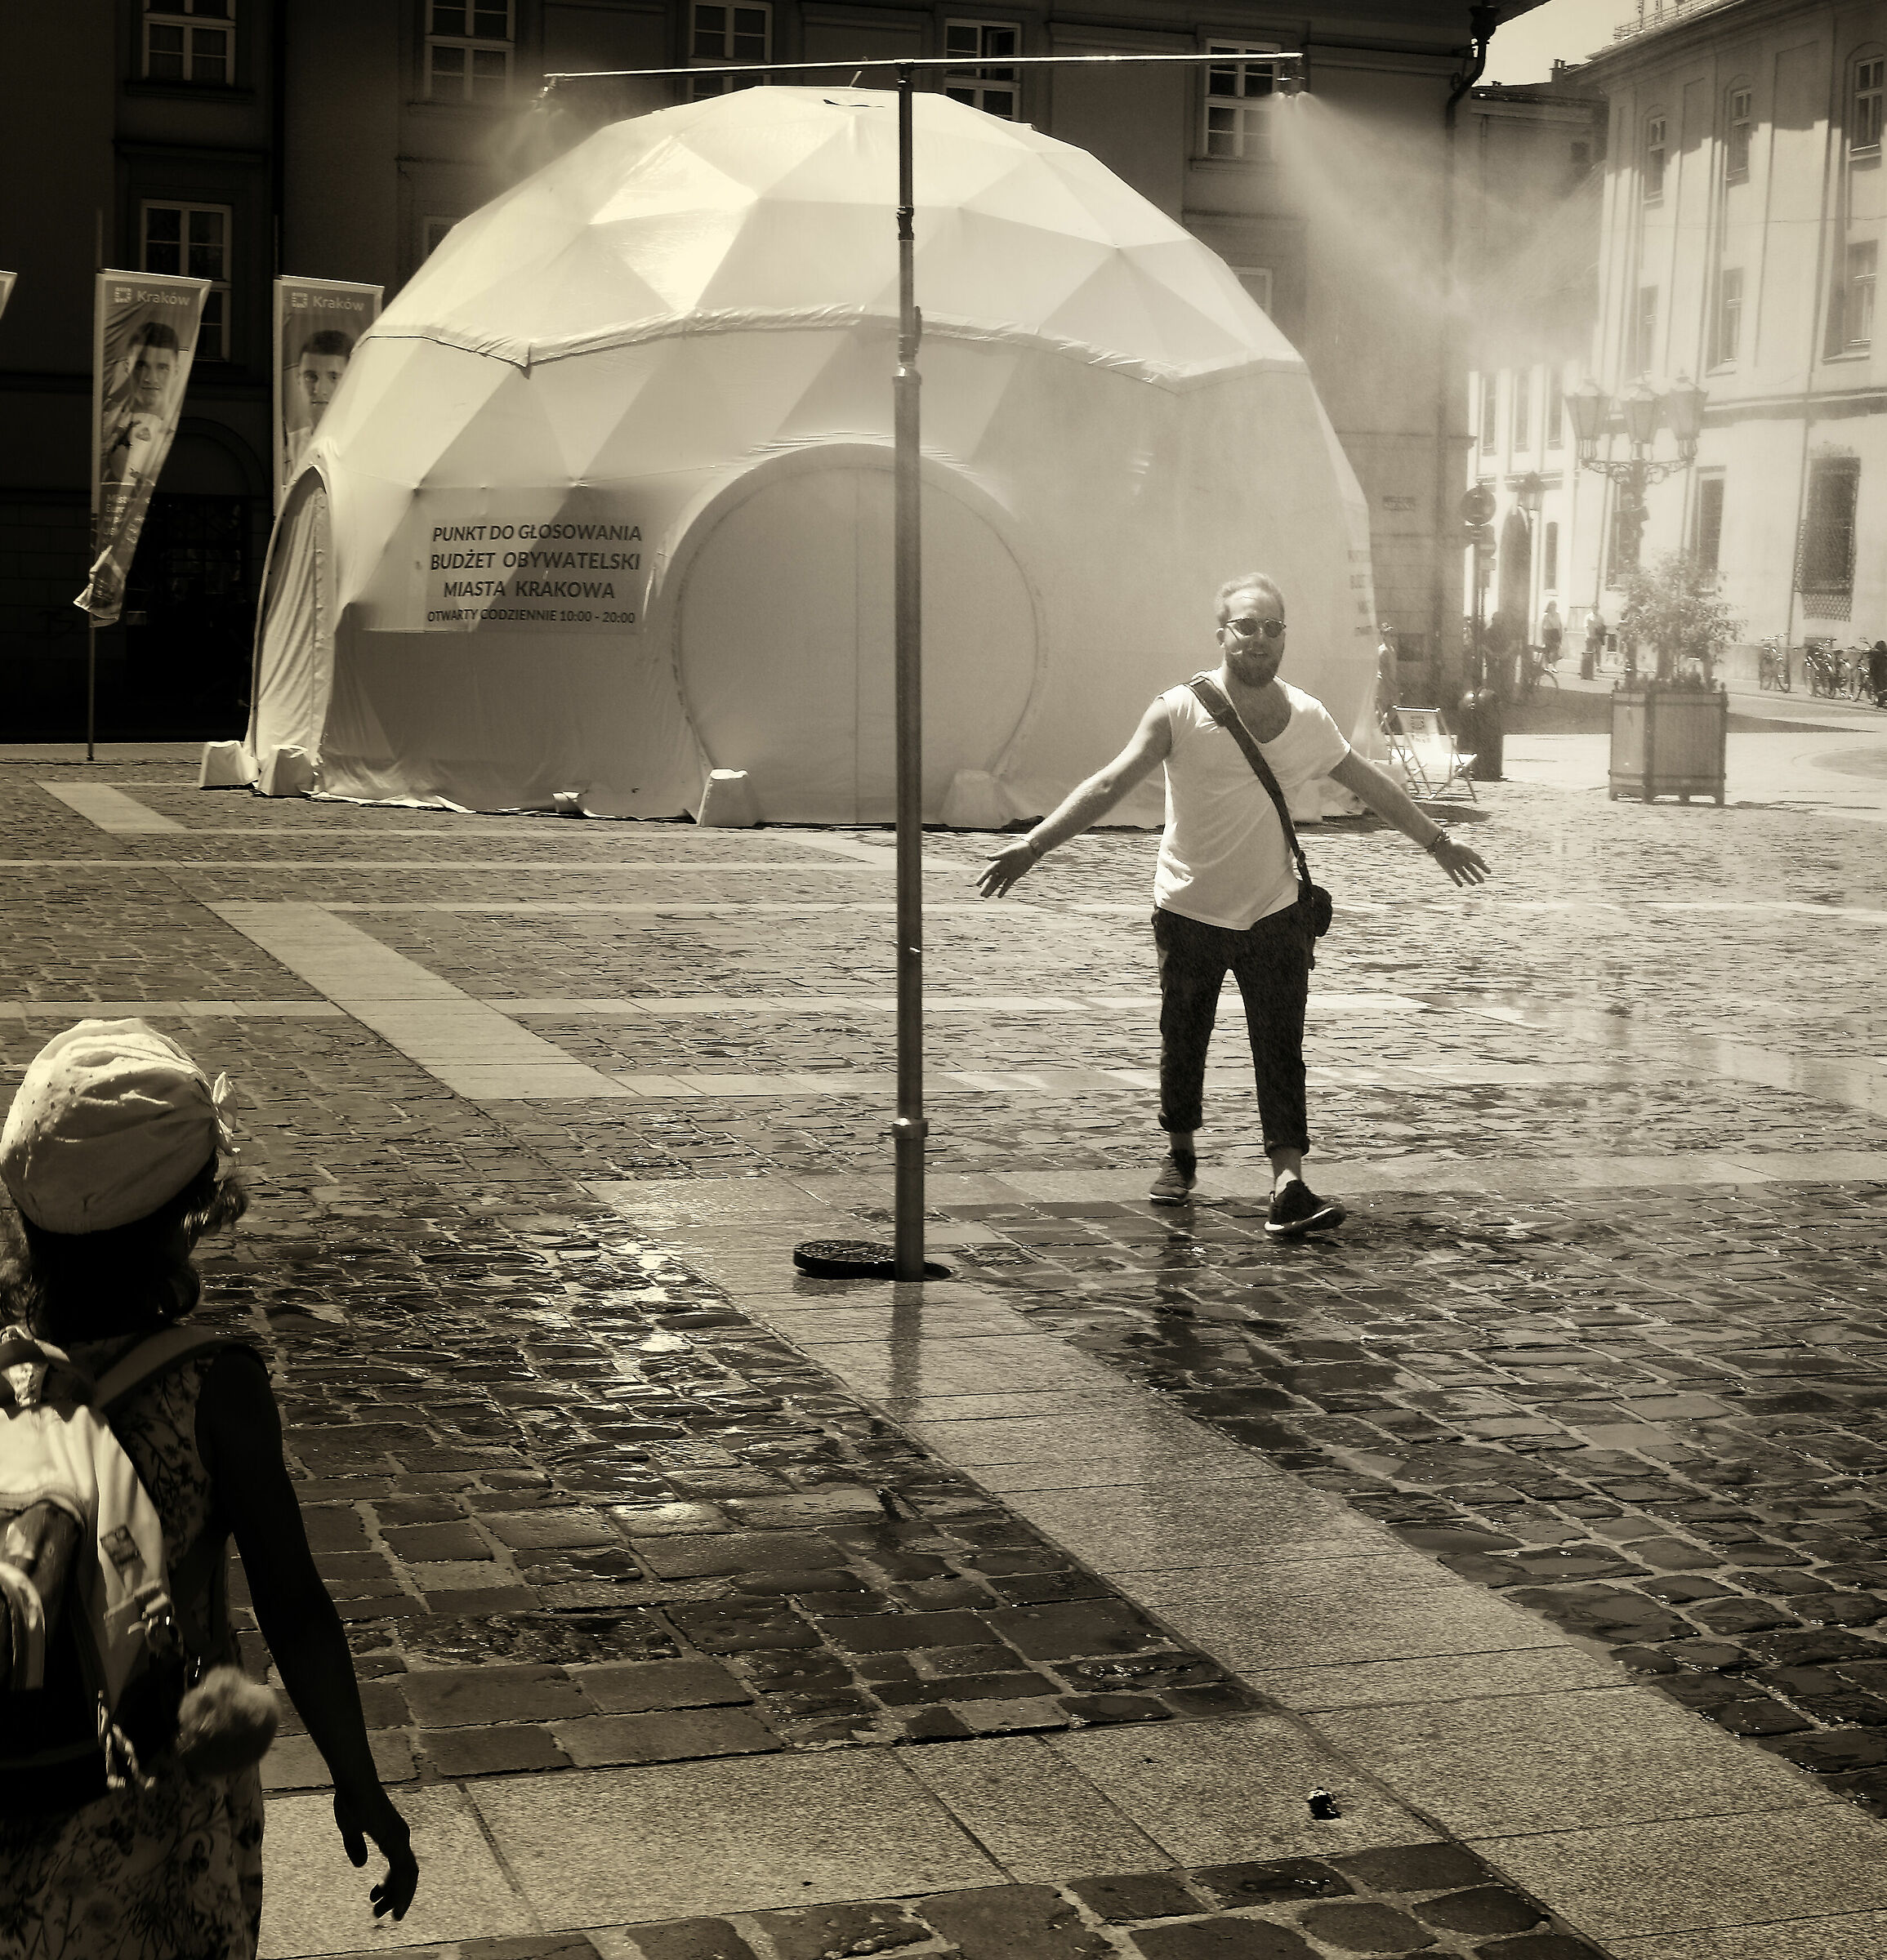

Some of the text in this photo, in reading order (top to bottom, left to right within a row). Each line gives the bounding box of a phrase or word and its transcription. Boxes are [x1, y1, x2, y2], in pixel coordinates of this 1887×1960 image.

[137, 290, 190, 305] Kraków
[313, 296, 364, 311] Kraków
[433, 523, 642, 541] PUNKT DO GŁOSOWANIA
[430, 549, 640, 570] BUDŻET OBYWATELSKI
[444, 581, 614, 599] MIASTA KRAKOWA
[427, 608, 479, 621] OTWARTY
[480, 608, 556, 621] CODZIENNIE
[560, 610, 592, 621] 10:00
[602, 611, 636, 623] 20:00
